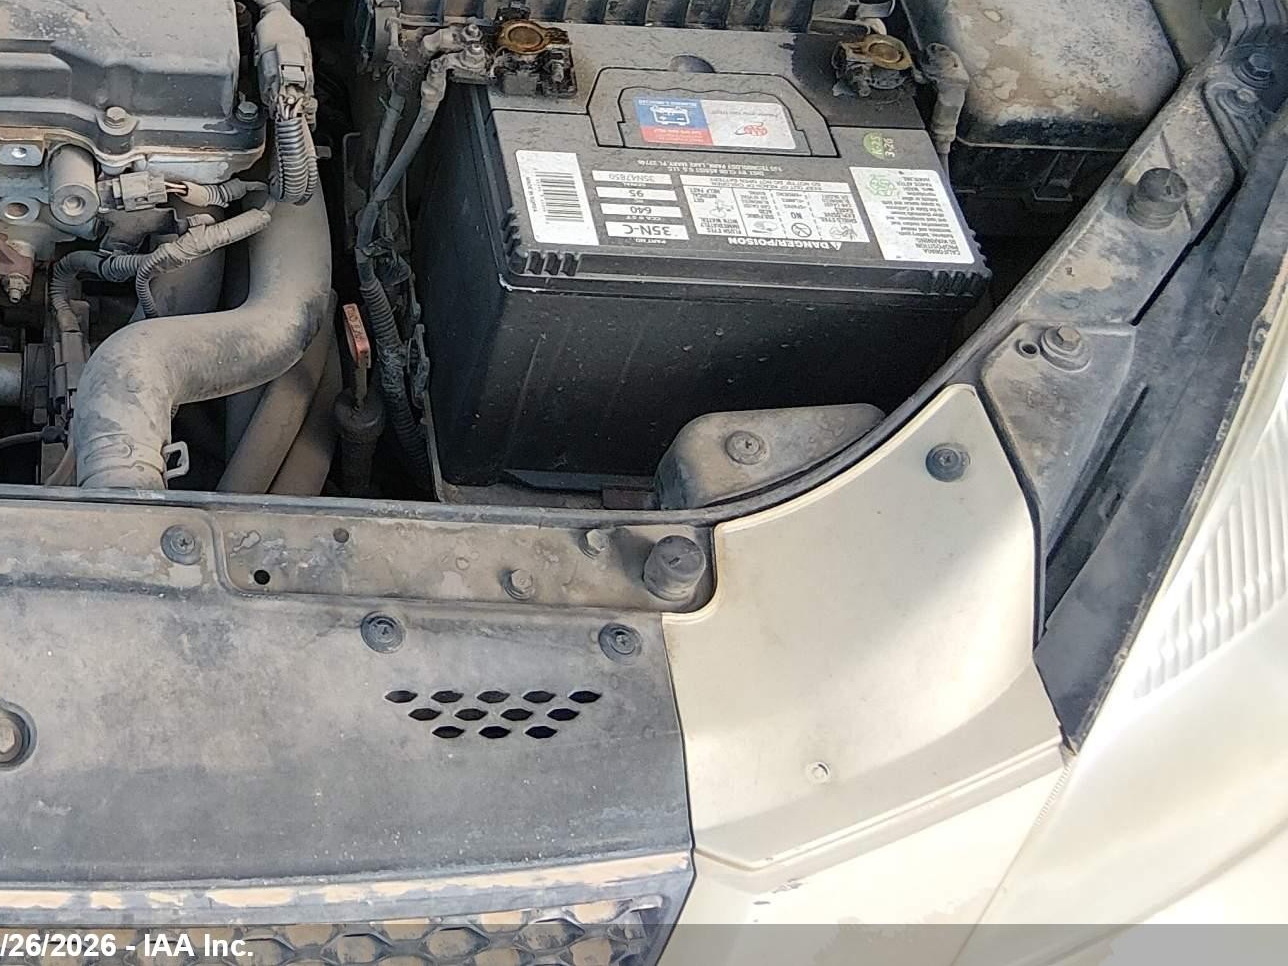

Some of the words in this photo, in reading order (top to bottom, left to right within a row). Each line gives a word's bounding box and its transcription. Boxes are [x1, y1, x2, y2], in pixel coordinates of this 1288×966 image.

[628, 189, 644, 197] 95
[630, 206, 652, 214] 640
[622, 224, 671, 235] 35N-C
[728, 237, 830, 249] DANGER/POISON
